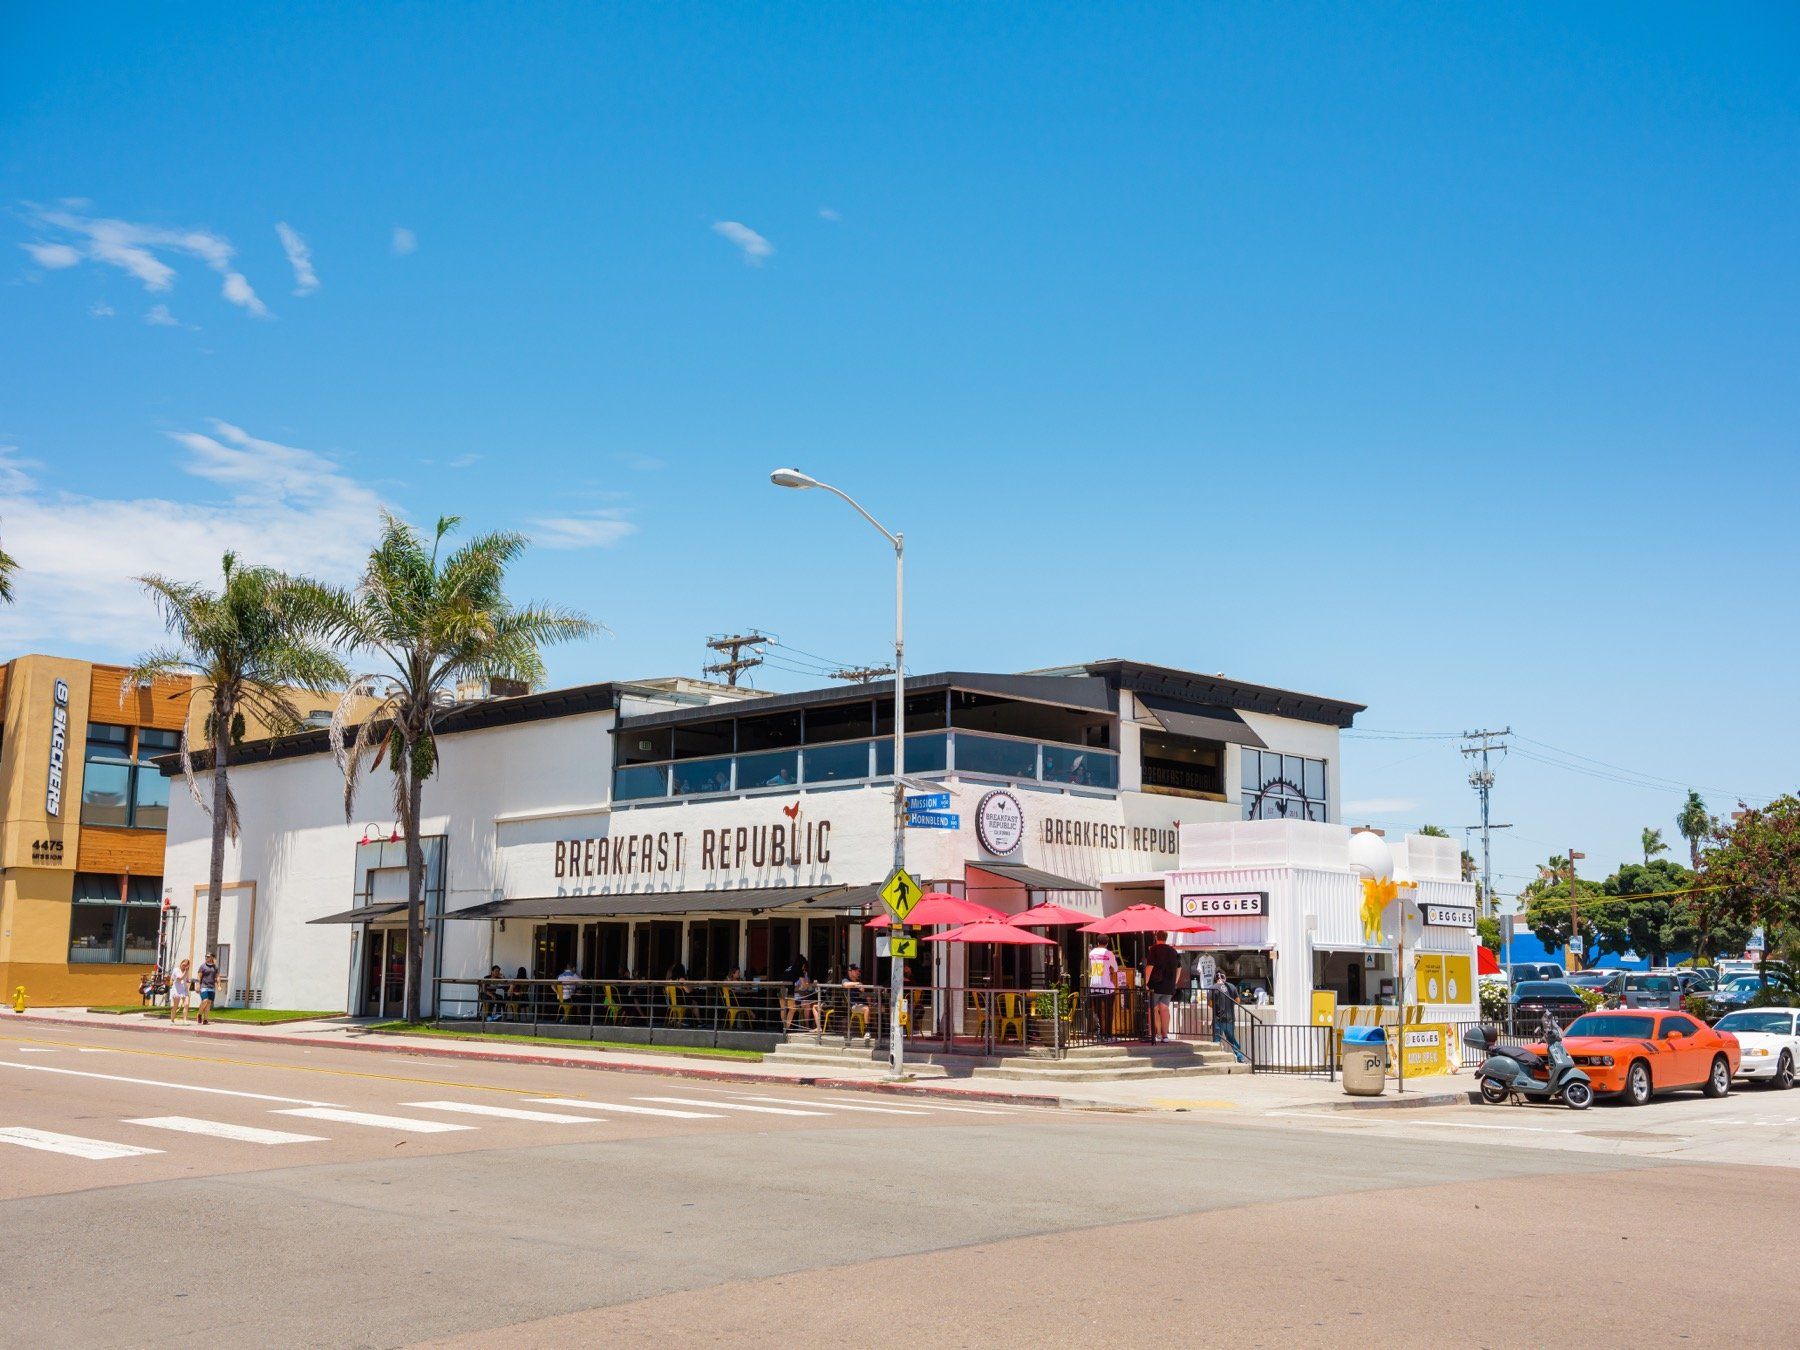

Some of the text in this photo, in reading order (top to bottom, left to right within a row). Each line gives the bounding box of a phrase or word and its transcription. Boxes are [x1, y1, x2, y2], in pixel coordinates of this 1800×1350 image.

[46, 706, 67, 817] SKECHERS
[986, 813, 1019, 823] BREAKFAST
[988, 821, 1017, 830] REPUBLIC
[1045, 817, 1126, 850] BREAKFAST
[32, 840, 63, 851] 4475
[555, 820, 831, 878] BREAKFAST REPUBLIC
[1367, 954, 1372, 962] A
[1367, 1055, 1381, 1071] pb
